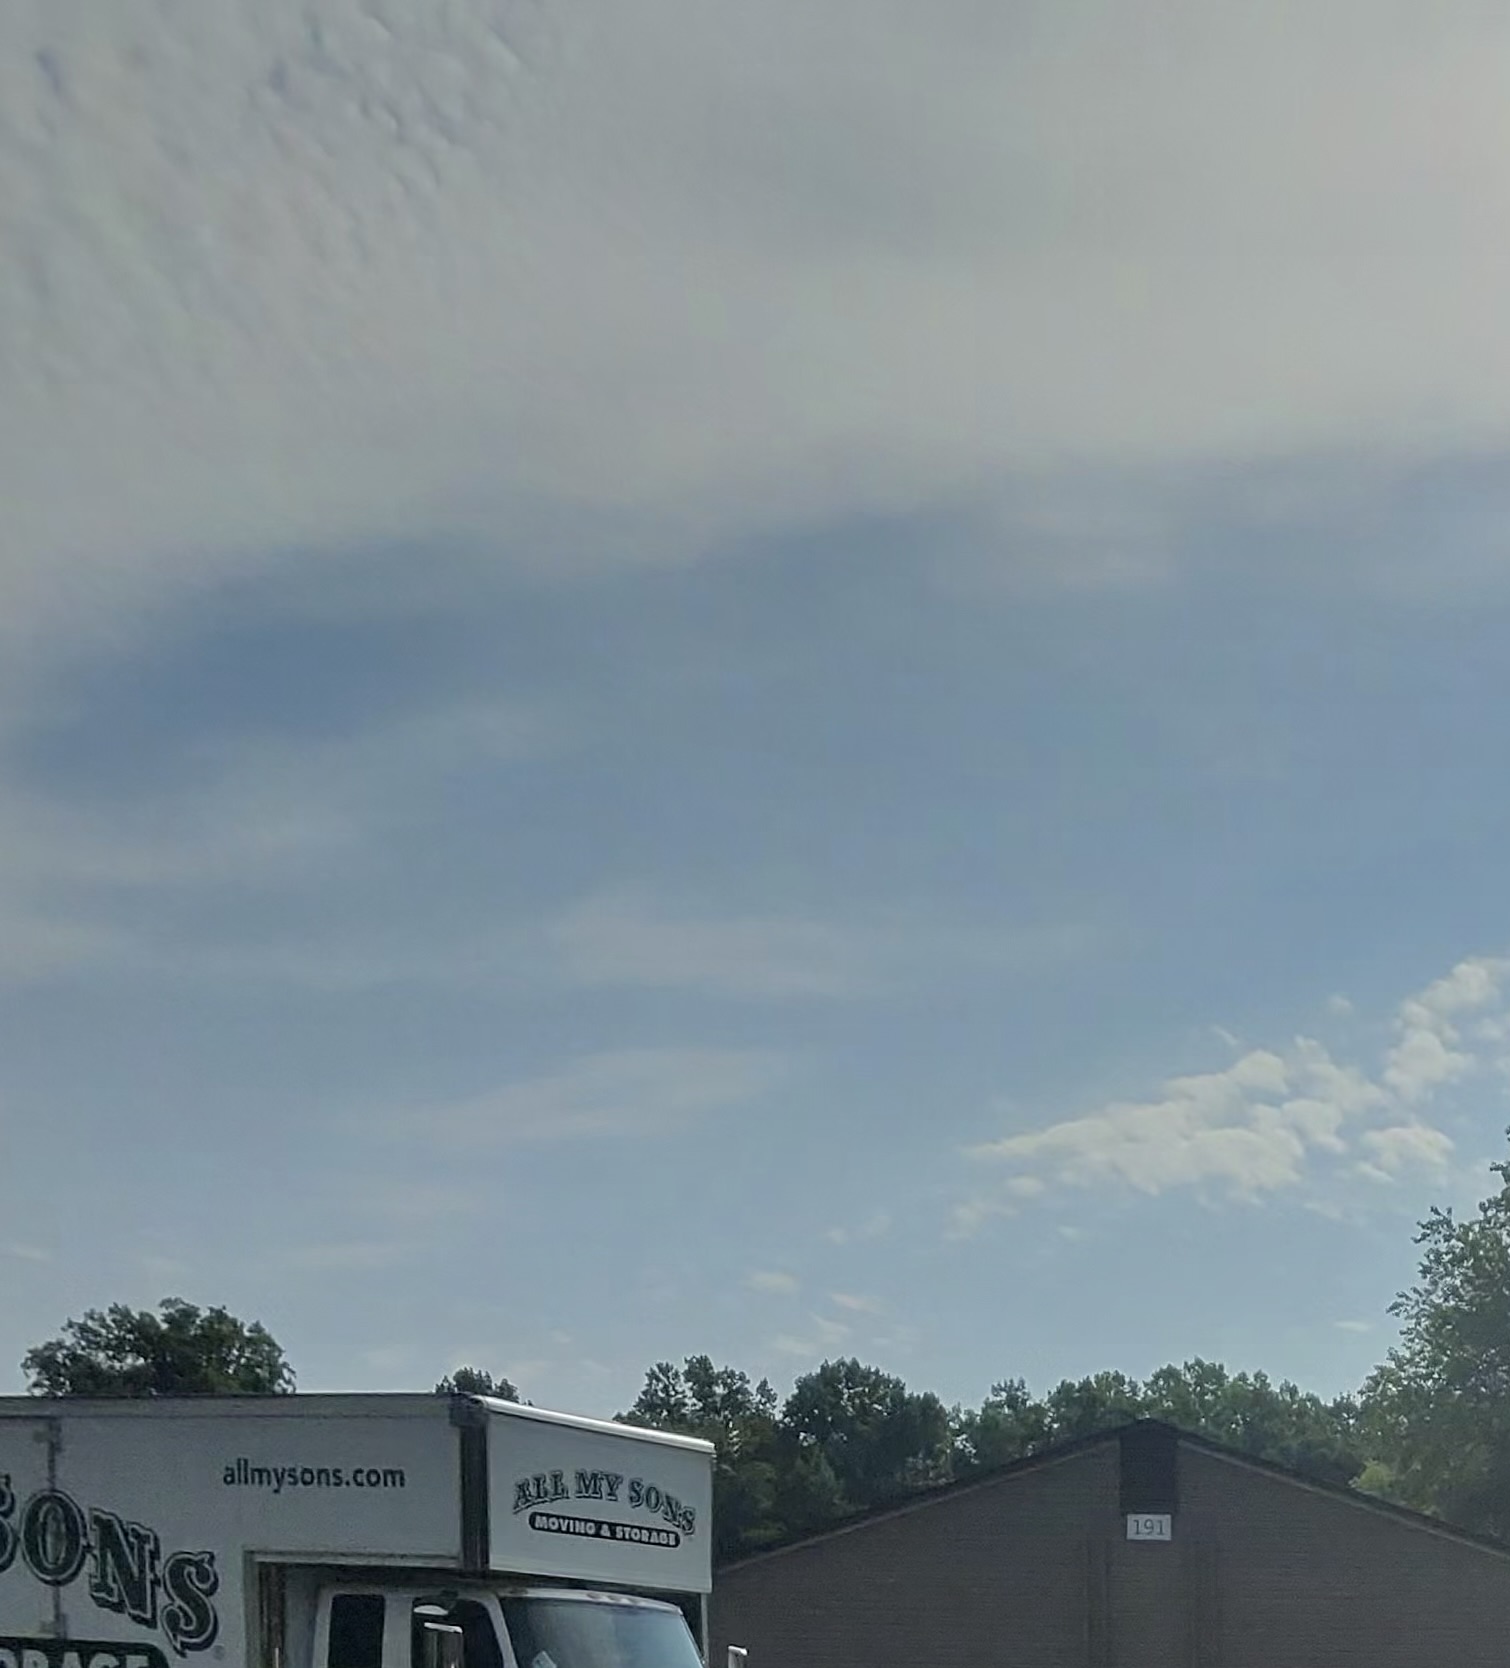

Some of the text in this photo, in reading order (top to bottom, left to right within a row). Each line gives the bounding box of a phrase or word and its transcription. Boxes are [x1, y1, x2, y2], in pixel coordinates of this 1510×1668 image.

[223, 1457, 406, 1494] allmysons.com
[513, 1469, 696, 1537] ALL MY SONS
[534, 1514, 677, 1547] MOVING & STORAGE
[1133, 1518, 1165, 1536] 191
